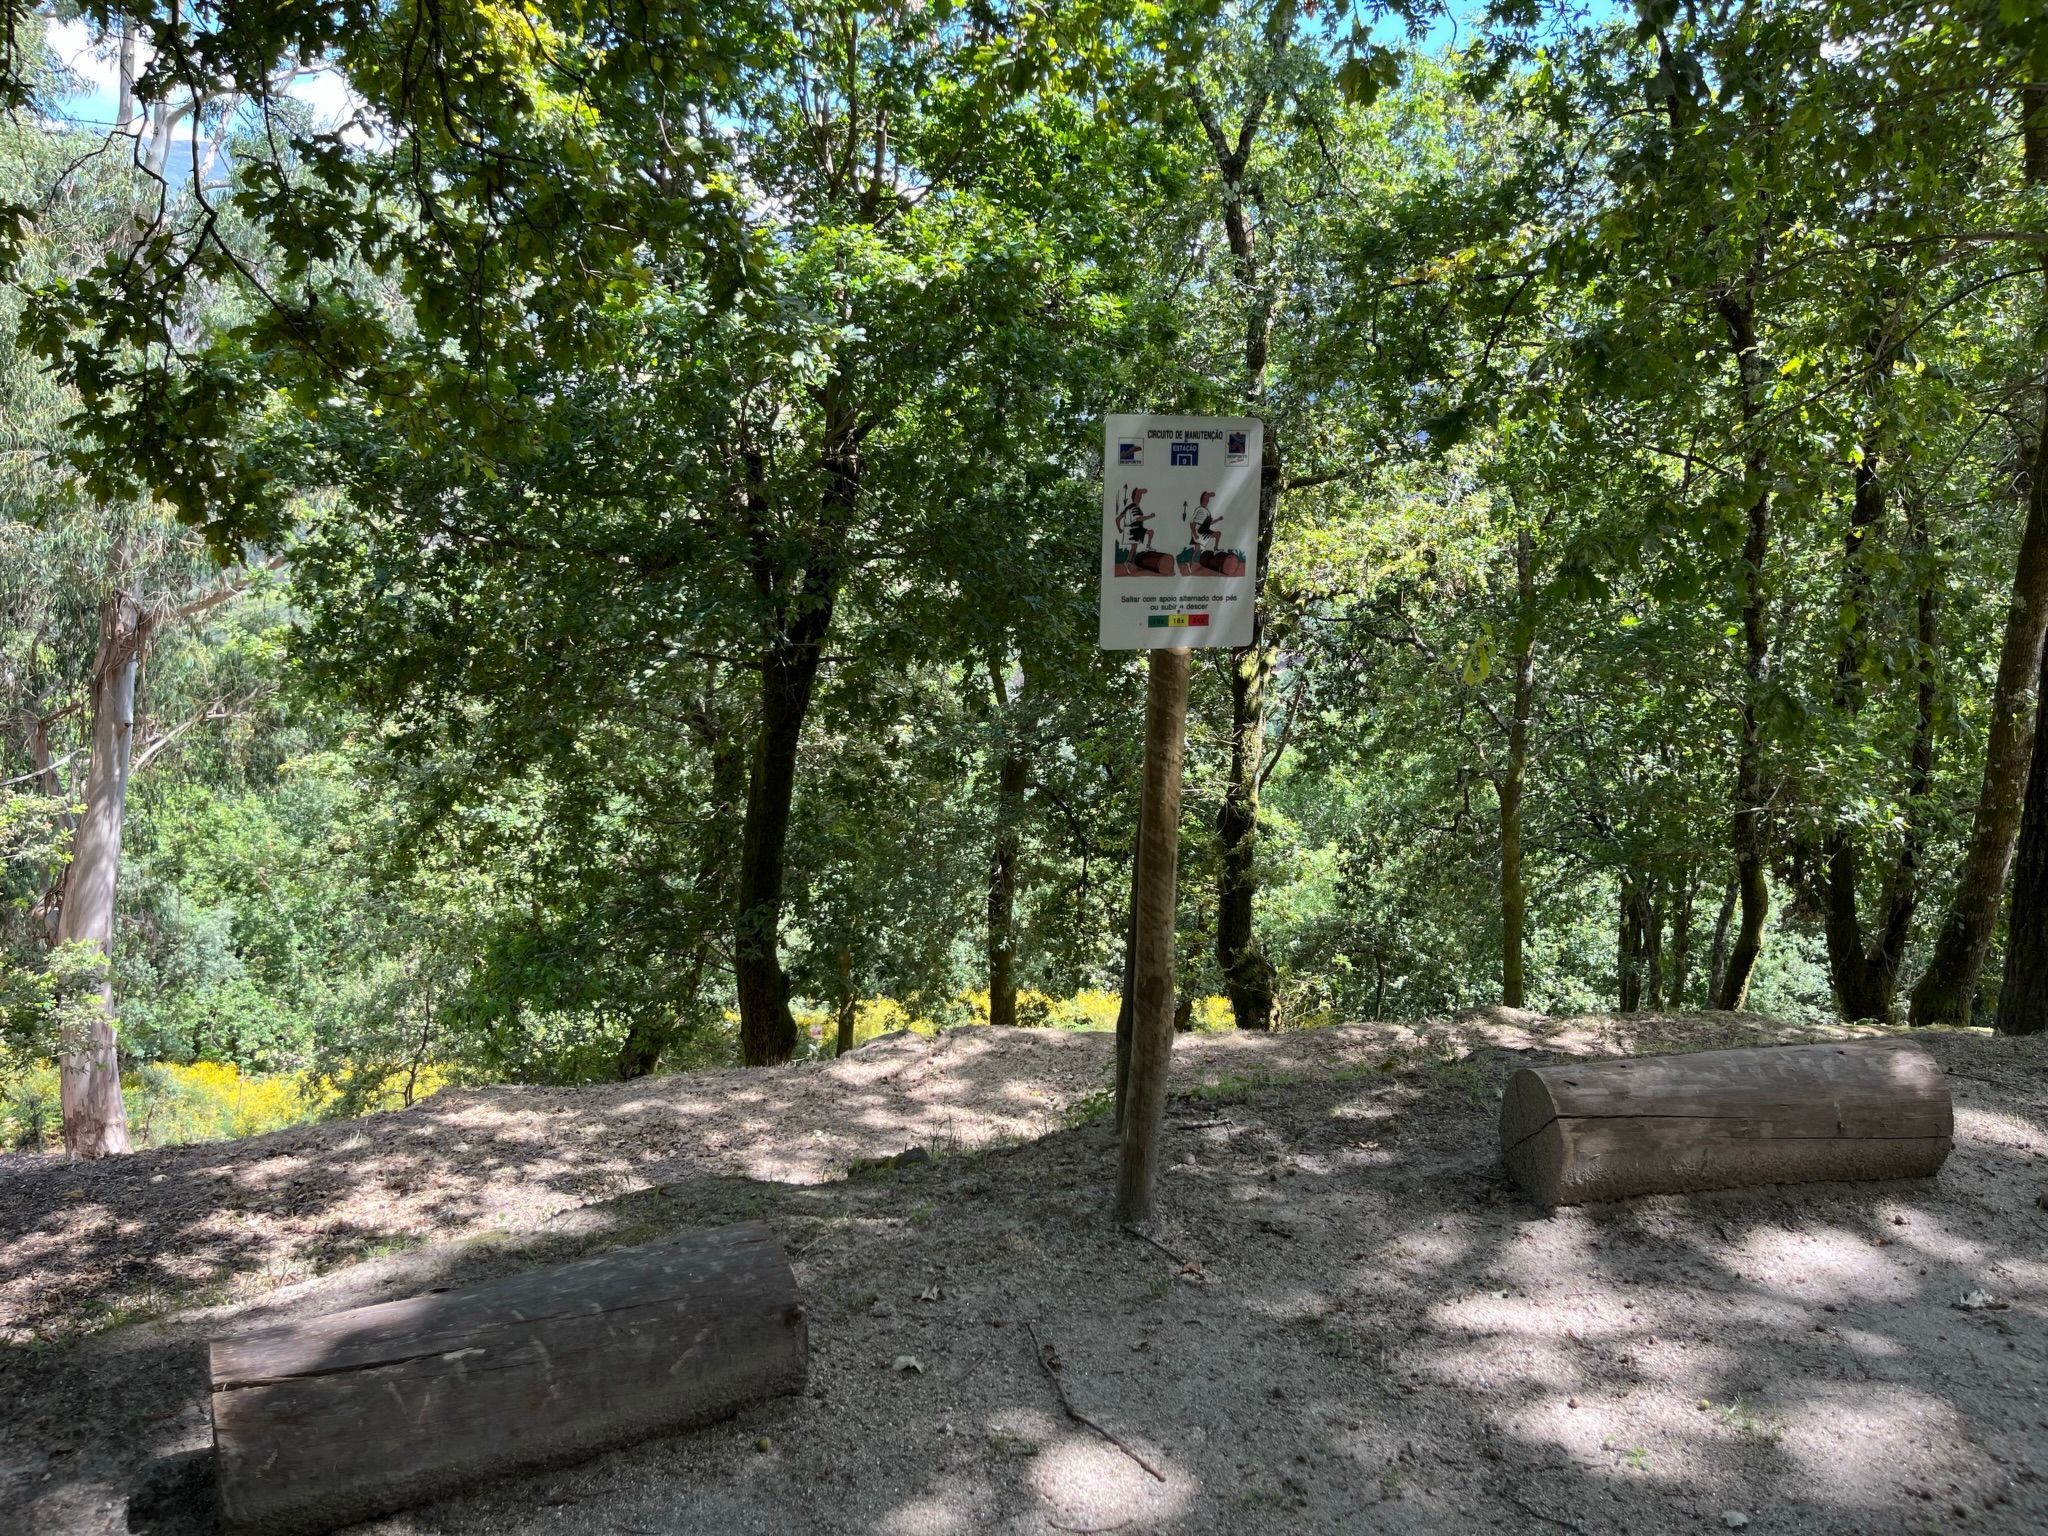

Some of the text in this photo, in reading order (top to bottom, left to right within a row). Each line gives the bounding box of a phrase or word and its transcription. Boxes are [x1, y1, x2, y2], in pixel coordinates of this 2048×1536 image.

[1148, 429, 1223, 442] CIRCUITO DE MANUTENÇÃO
[1172, 444, 1197, 453] ESTAÇÃO
[1159, 595, 1176, 603] apoio
